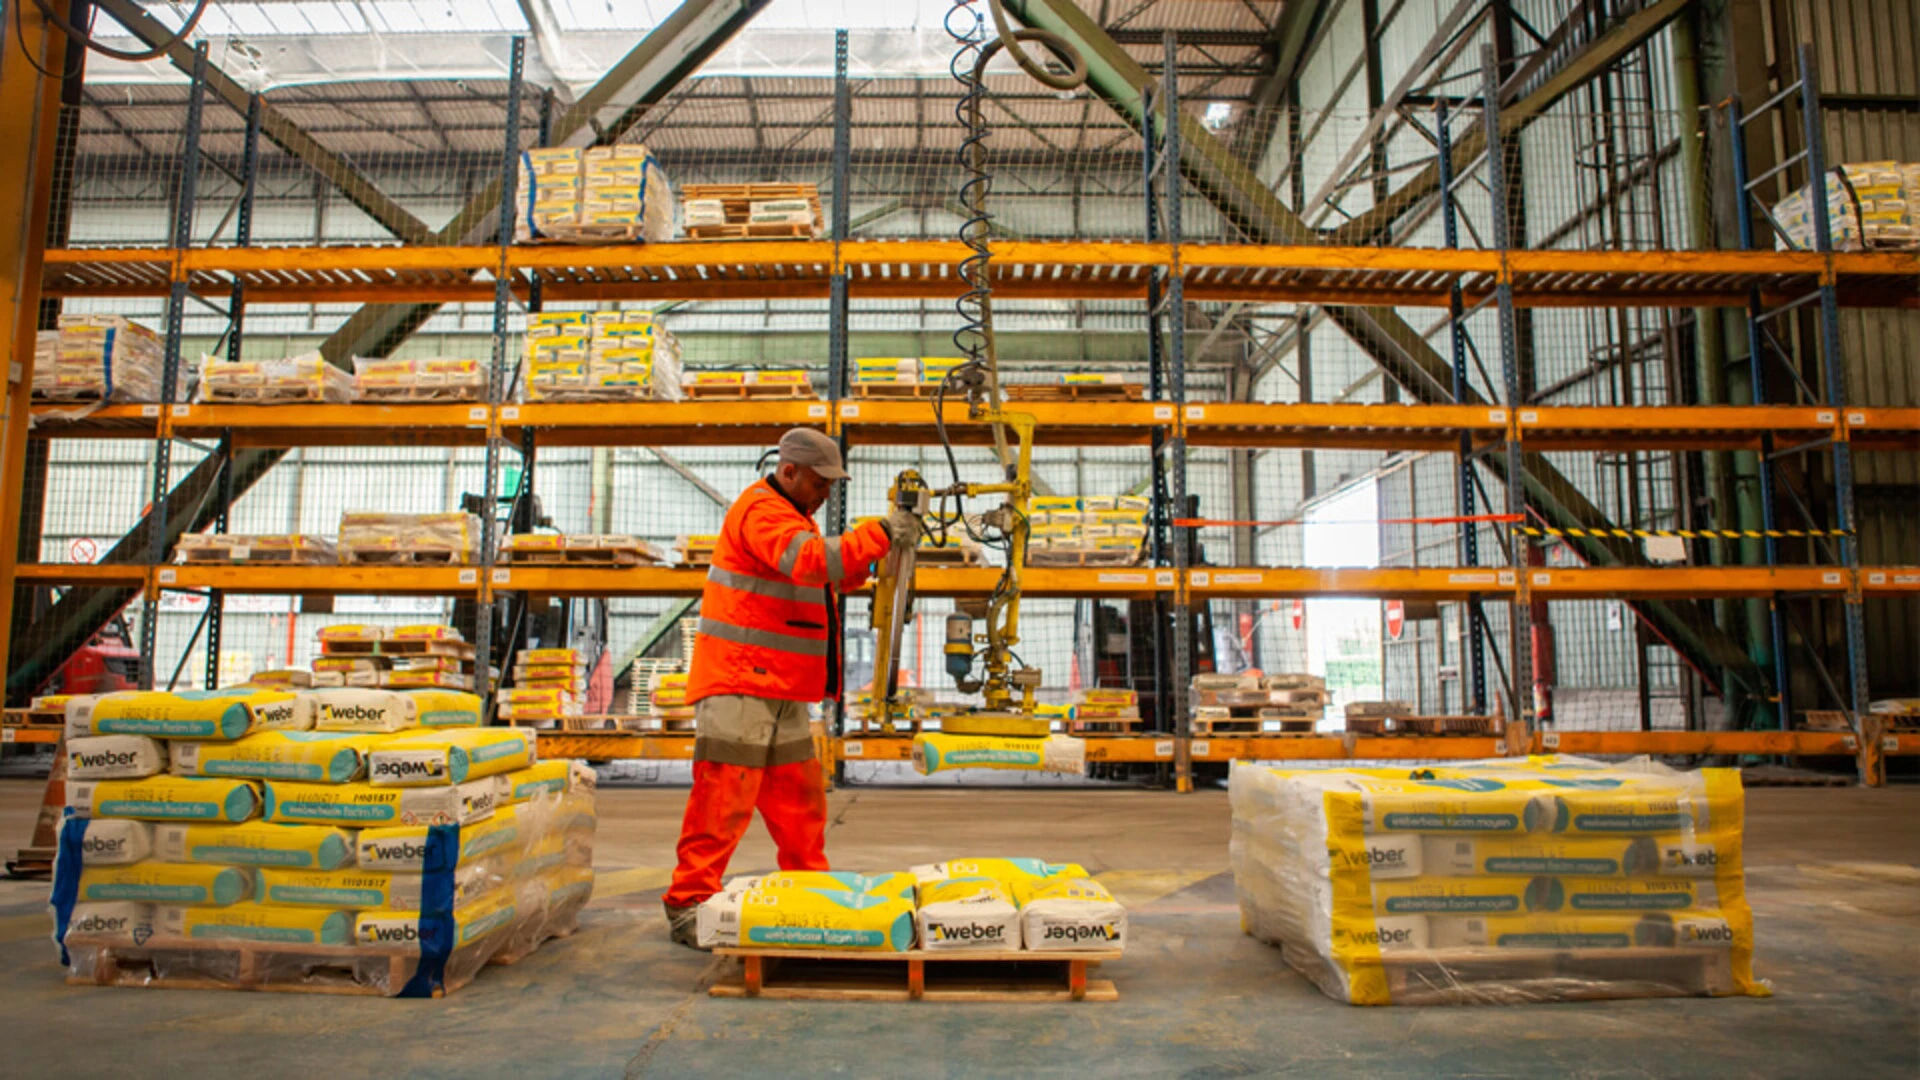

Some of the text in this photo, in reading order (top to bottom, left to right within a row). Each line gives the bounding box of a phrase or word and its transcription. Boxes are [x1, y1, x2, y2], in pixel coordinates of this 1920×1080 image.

[331, 705, 386, 720] weber
[81, 750, 137, 768] weber
[374, 761, 427, 778] weber
[82, 836, 126, 852] eber
[943, 922, 1005, 939] weber
[1044, 925, 1107, 942] weber
